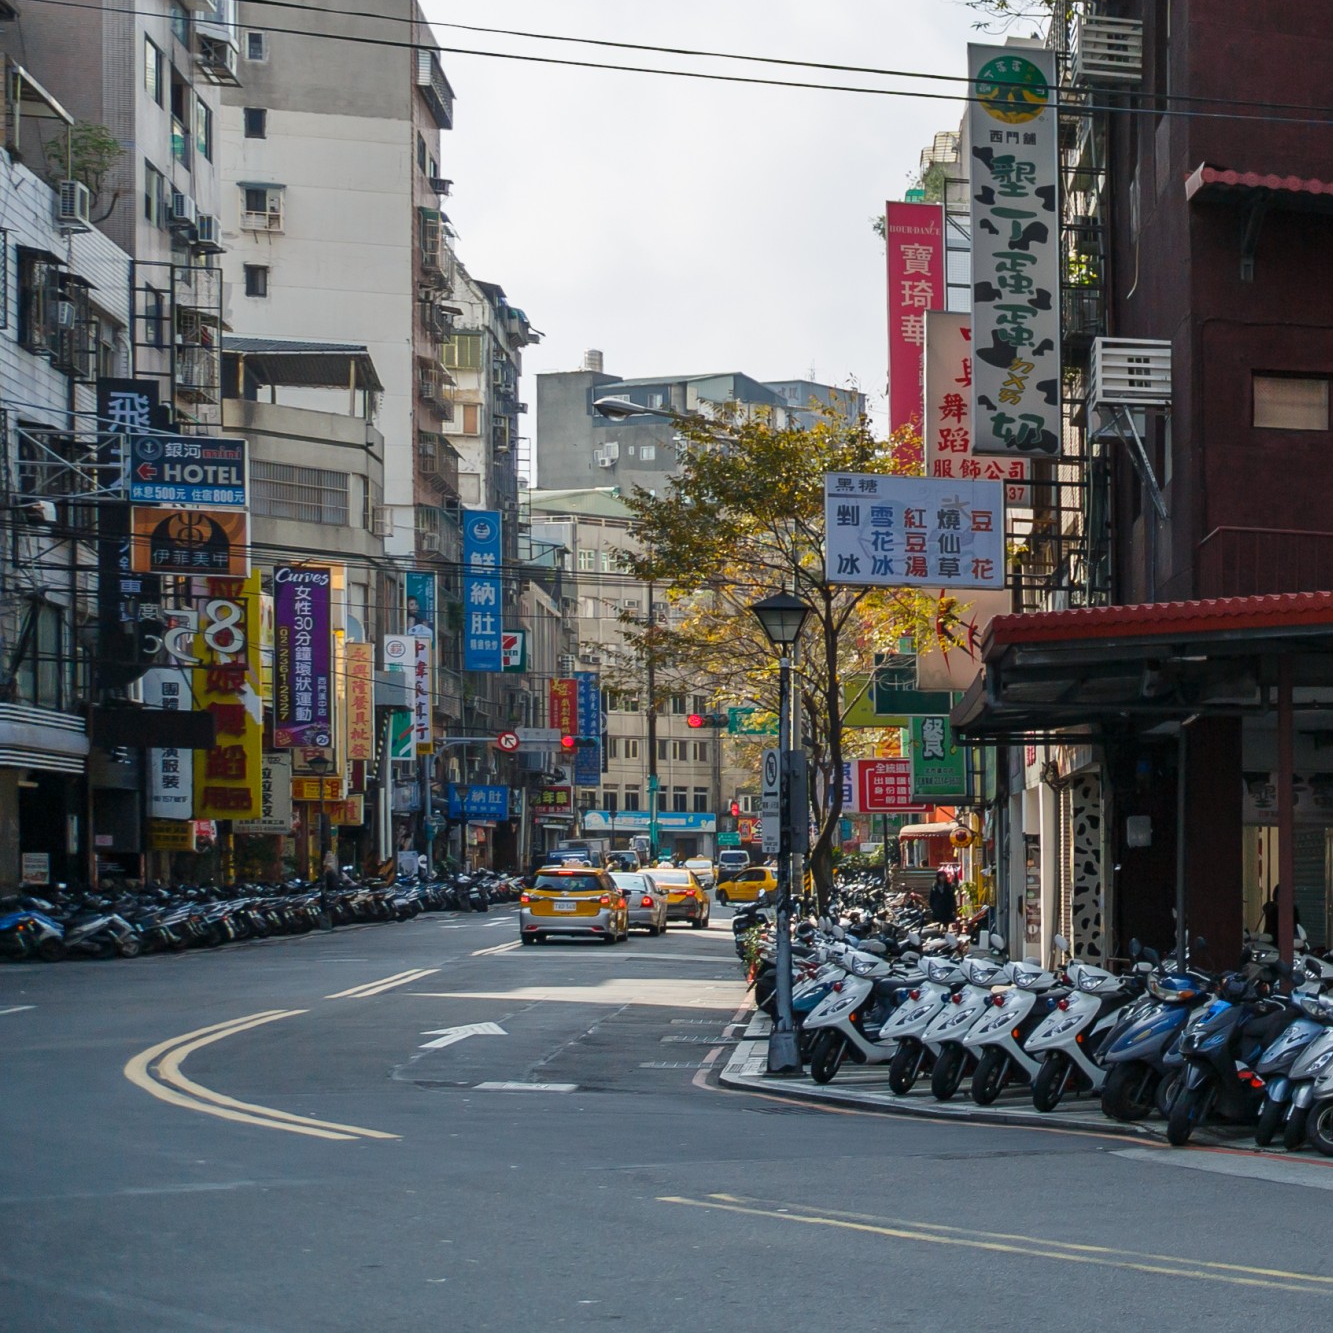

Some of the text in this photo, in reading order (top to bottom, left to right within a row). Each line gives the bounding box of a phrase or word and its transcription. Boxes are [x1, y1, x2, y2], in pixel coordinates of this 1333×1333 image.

[165, 442, 202, 459] 銀河
[163, 463, 242, 485] HOTEL
[933, 459, 1025, 480] 服飾公司
[835, 478, 878, 494] 黑糖
[870, 505, 895, 576] 雪花冰
[903, 507, 929, 578] 紅豆湯
[936, 508, 962, 579] 燒仙草
[970, 510, 994, 580] 豆花
[274, 567, 330, 585] Curves
